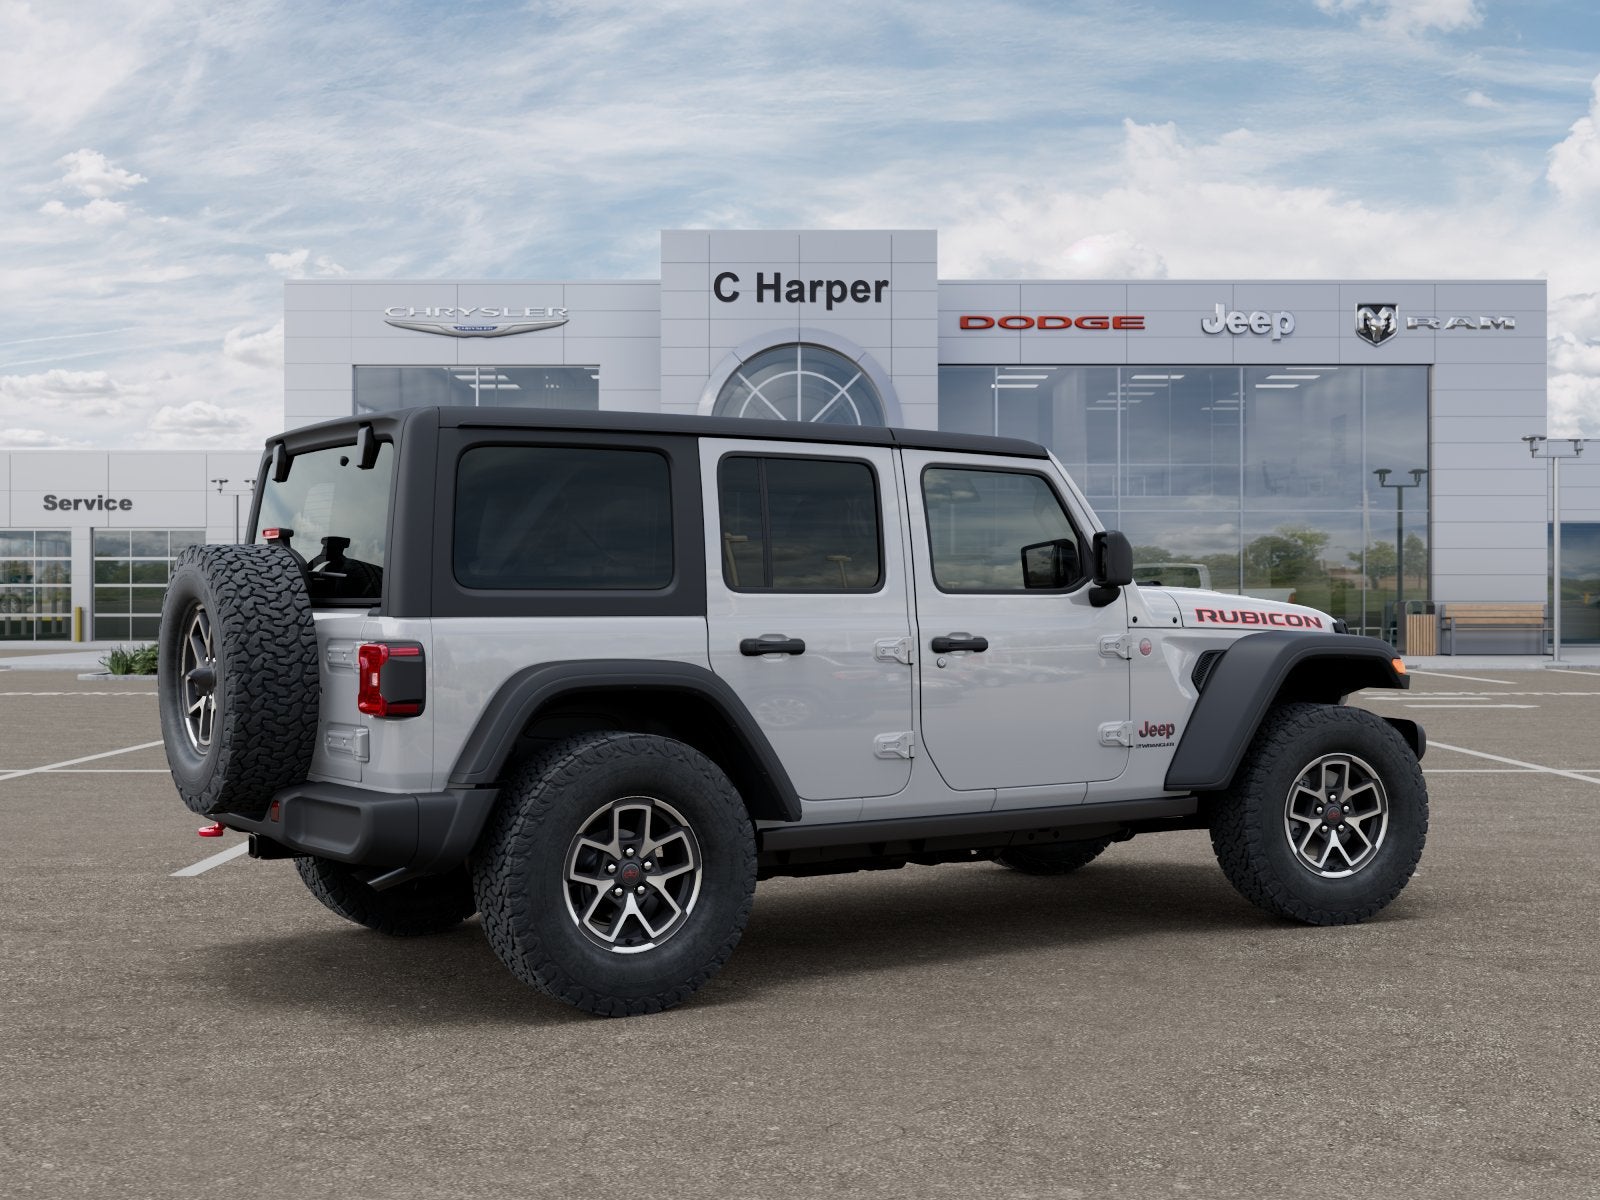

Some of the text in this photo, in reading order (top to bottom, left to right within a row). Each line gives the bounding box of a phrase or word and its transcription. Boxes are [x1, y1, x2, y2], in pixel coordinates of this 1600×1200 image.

[713, 271, 890, 311] C Harper
[384, 306, 569, 318] CHRYSLER
[959, 315, 1146, 330] DODGE
[1201, 303, 1295, 341] Jeep
[1406, 316, 1516, 330] RAM
[43, 494, 133, 511] Service
[1195, 608, 1323, 629] RUBICON
[1138, 720, 1175, 739] Jeep
